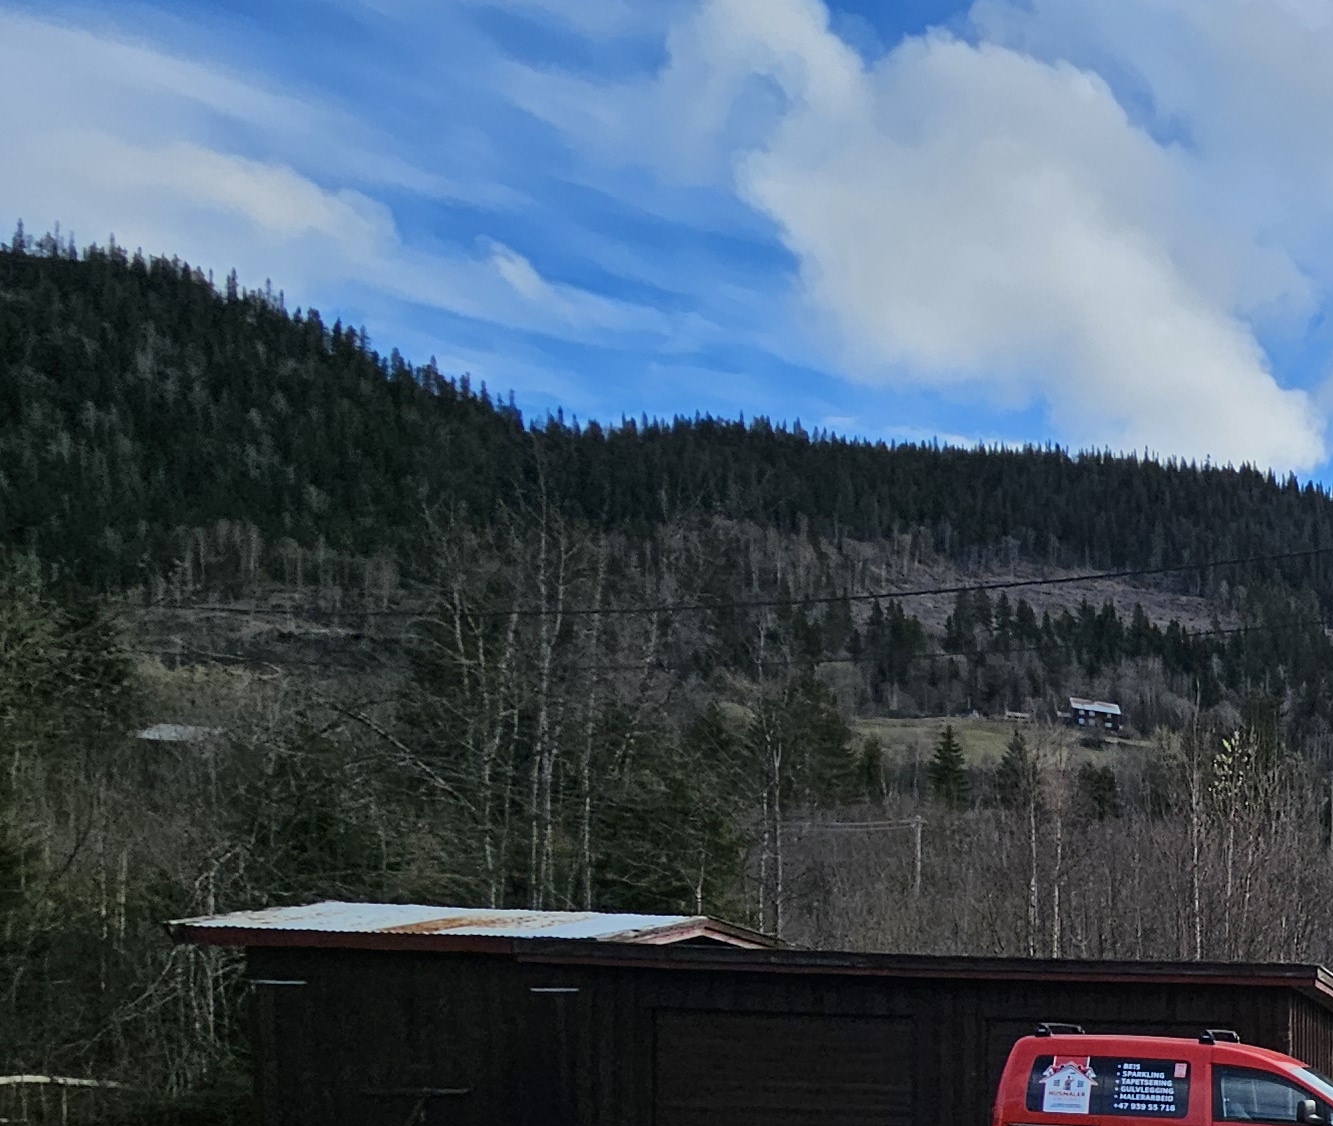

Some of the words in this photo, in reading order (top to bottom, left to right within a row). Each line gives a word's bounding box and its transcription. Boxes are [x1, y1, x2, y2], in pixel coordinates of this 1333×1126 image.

[1122, 1071, 1165, 1079] SPARKLING
[1121, 1078, 1173, 1087] TAPETSERING
[1120, 1086, 1174, 1095] GULVLEGGING
[1119, 1094, 1174, 1102] MALERARBEID
[1113, 1102, 1129, 1110] +47
